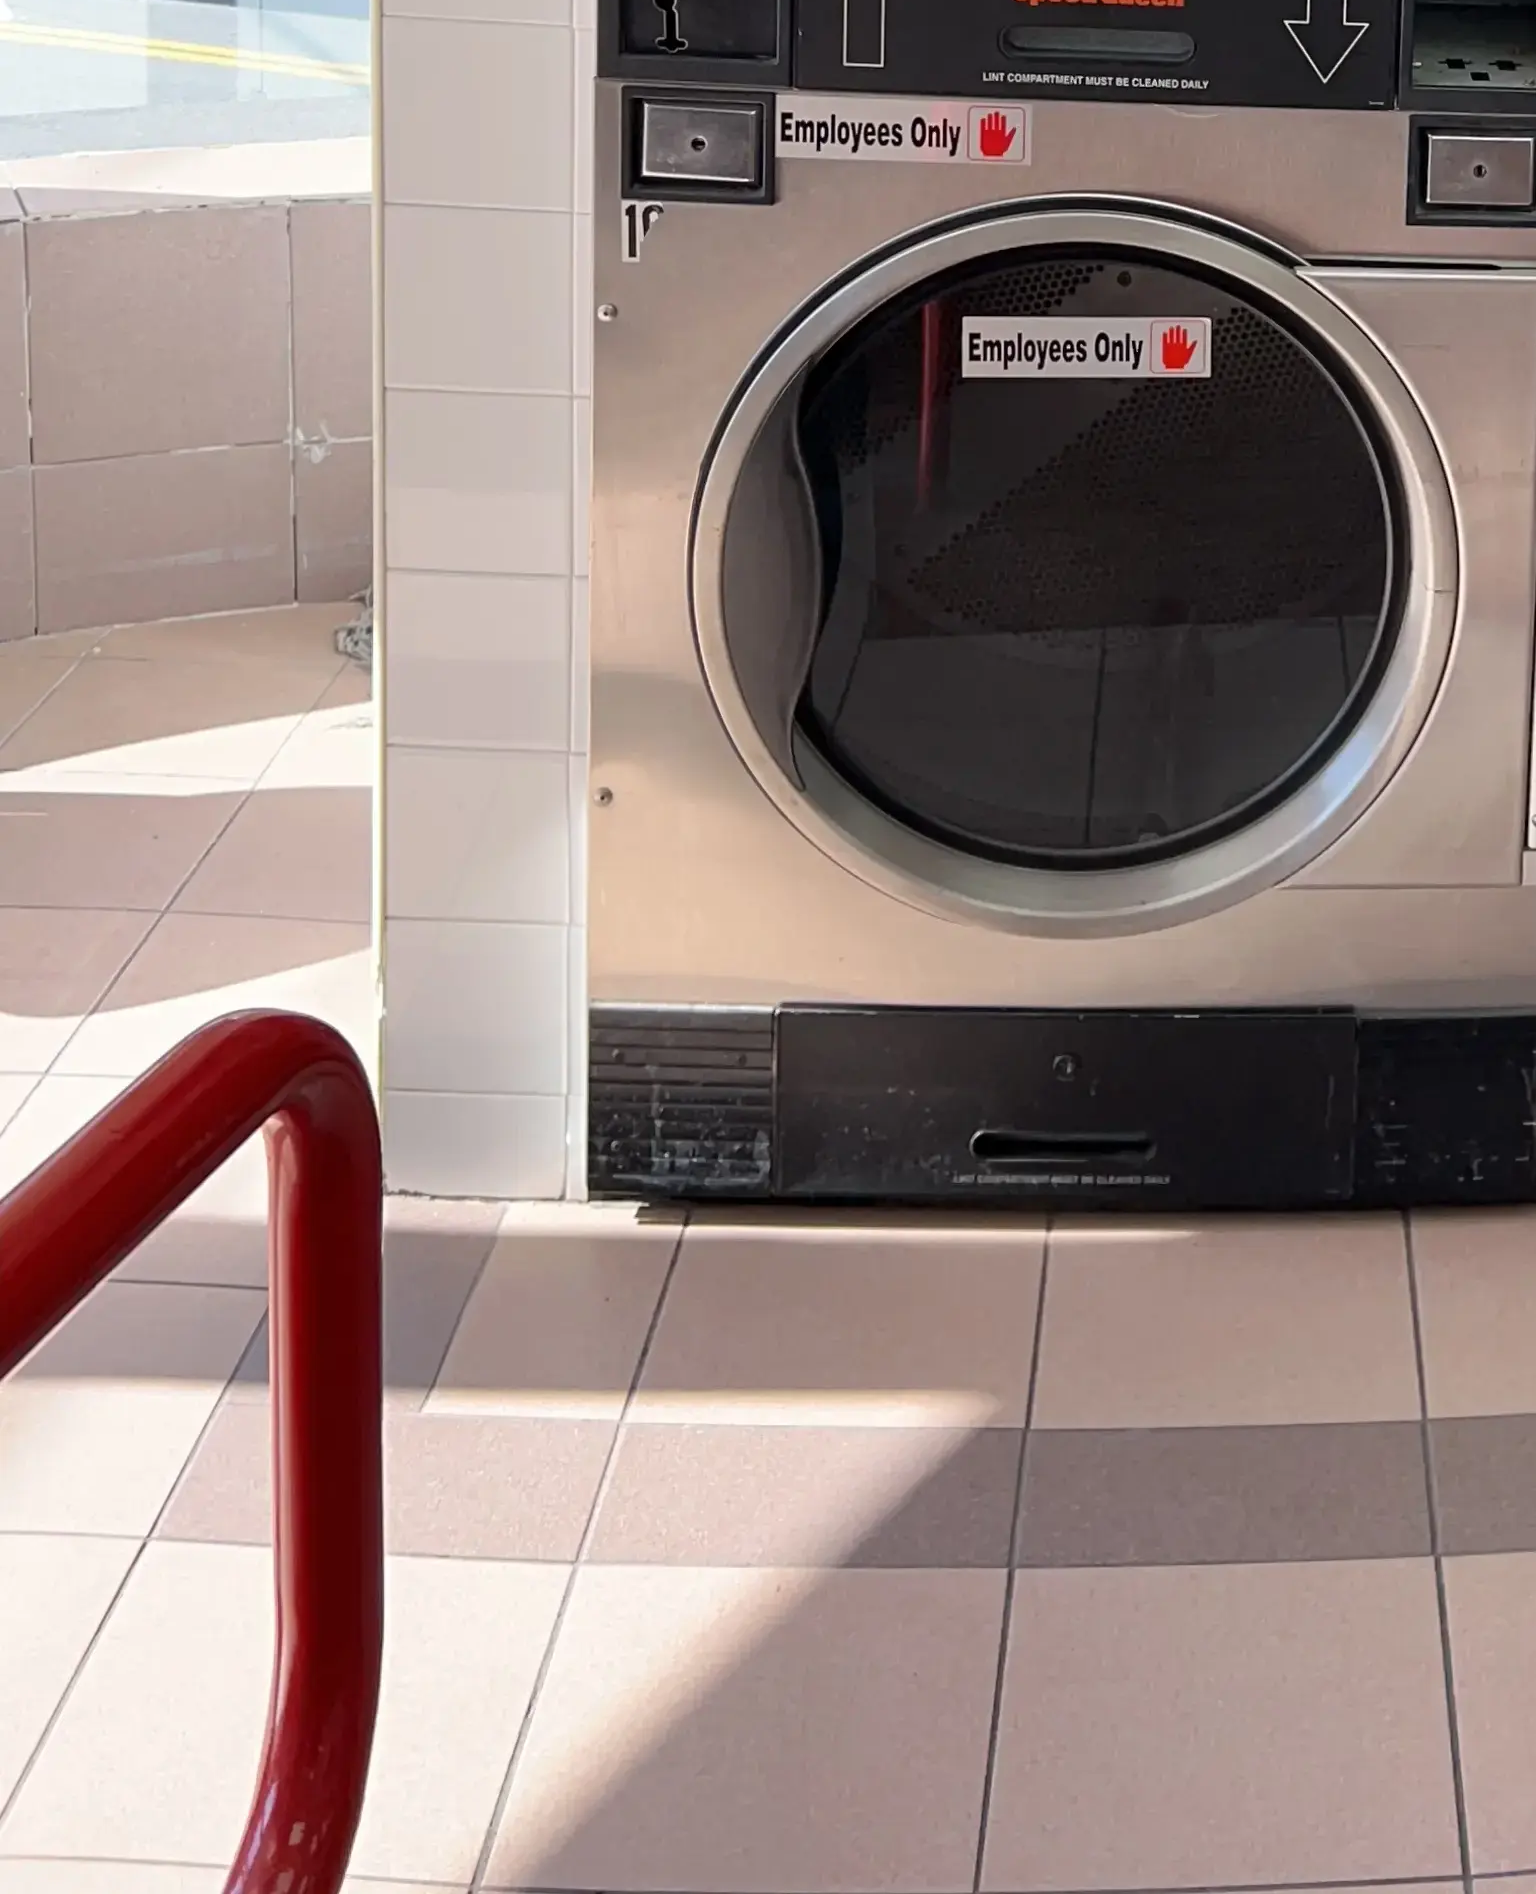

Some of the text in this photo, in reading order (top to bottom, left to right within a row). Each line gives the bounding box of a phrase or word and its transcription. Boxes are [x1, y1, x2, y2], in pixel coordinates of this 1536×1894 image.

[982, 71, 1209, 90] LINT COMPARTMENT MUST BE CLEANED DAILY
[780, 111, 961, 157] Employees Only
[968, 331, 1144, 370] Employees Only
